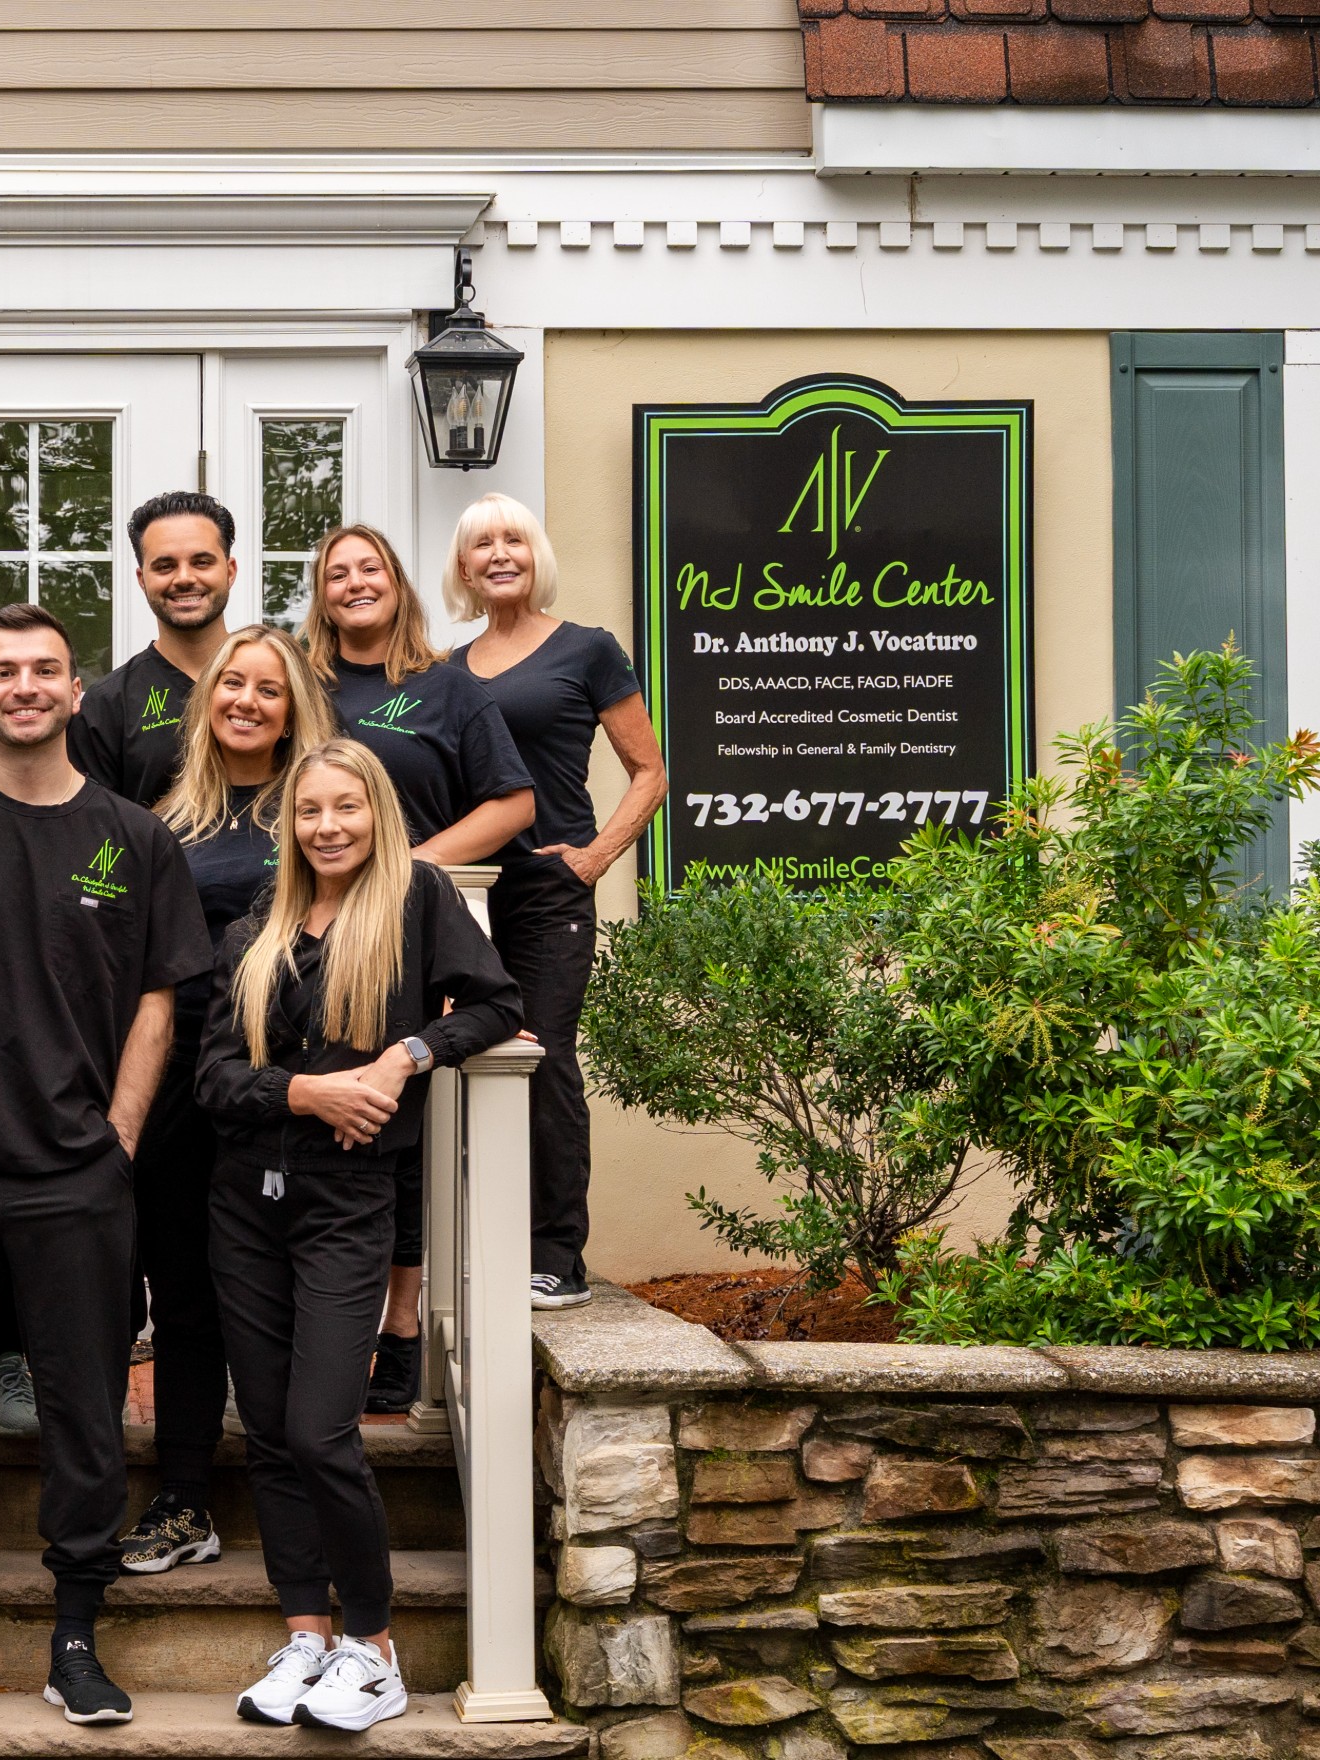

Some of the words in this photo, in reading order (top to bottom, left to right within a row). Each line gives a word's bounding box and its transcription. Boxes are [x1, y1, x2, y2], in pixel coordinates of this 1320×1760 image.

[754, 562, 862, 610] Smile
[873, 561, 995, 608] Center
[693, 632, 730, 654] Dr.
[734, 631, 839, 657] Anthony
[843, 630, 865, 652] J.
[869, 630, 978, 652] Vocaturo
[718, 677, 753, 692] DDS,
[754, 676, 812, 691] AAACD,
[815, 676, 855, 691] FACE,
[858, 675, 901, 690] FAGD,
[904, 675, 954, 688] FIADFE
[715, 710, 756, 725] Board
[758, 709, 833, 724] Accredited
[837, 709, 903, 723] Cosmetic
[907, 708, 959, 722] Dentist
[718, 743, 779, 759] Fellowship
[782, 744, 793, 755] in
[796, 743, 844, 755] General
[846, 743, 857, 755] &
[860, 742, 897, 757] Family
[900, 742, 957, 757] Dentistry
[686, 789, 990, 828] 732-677-2777
